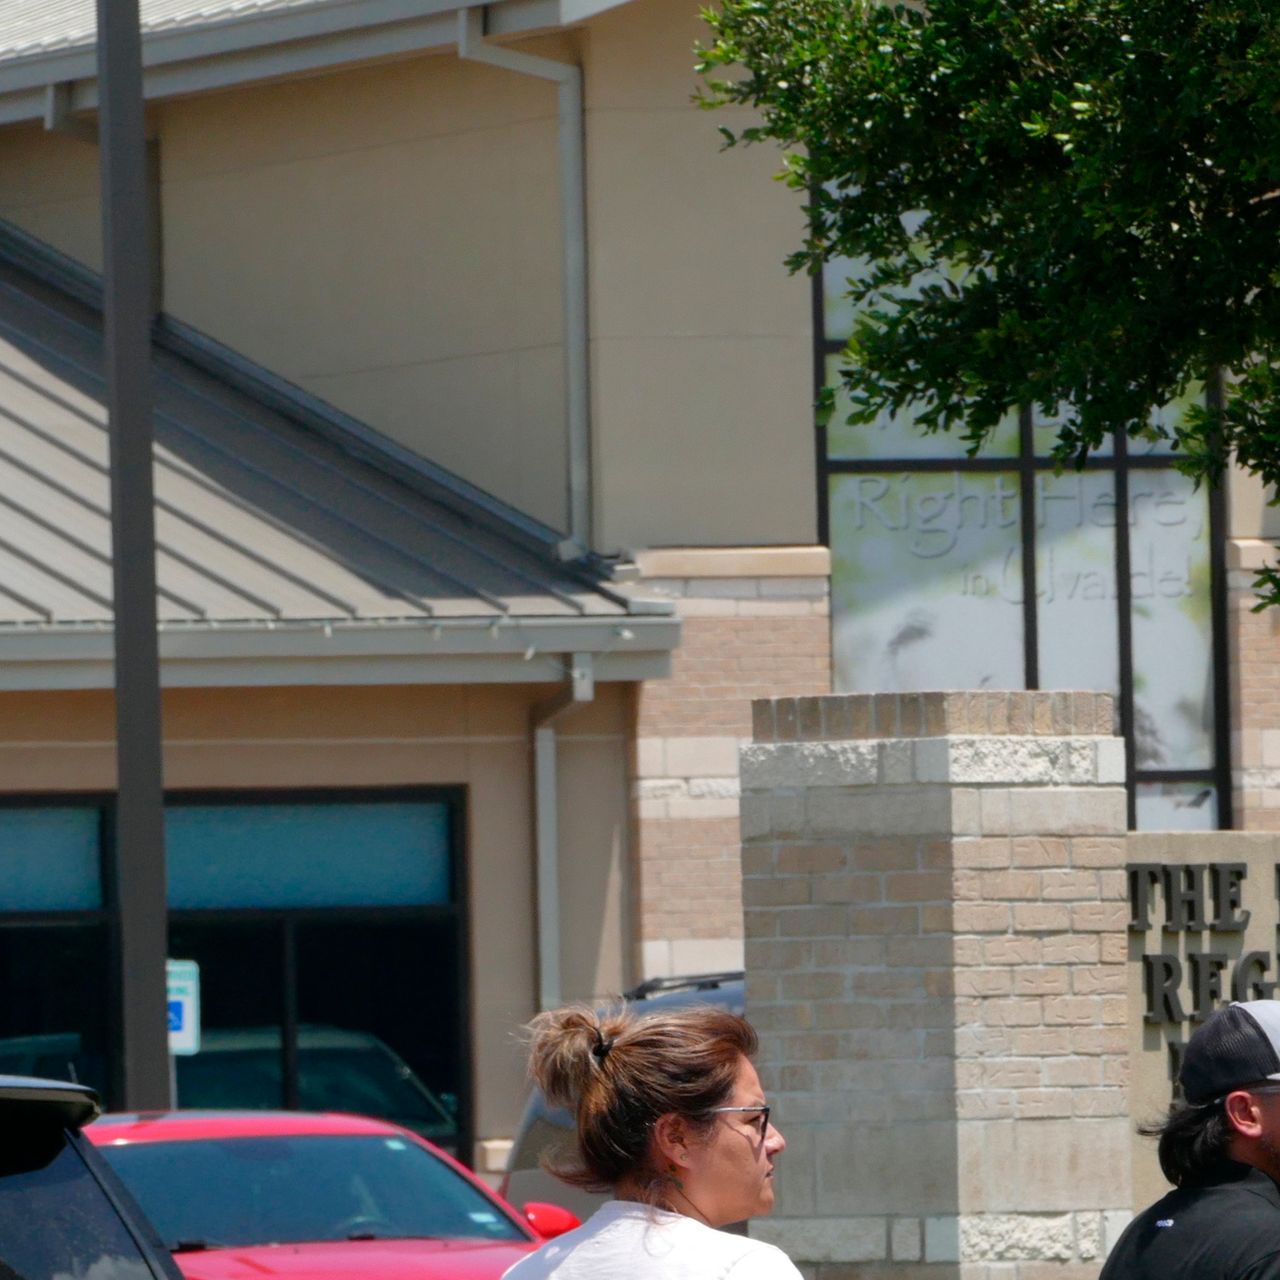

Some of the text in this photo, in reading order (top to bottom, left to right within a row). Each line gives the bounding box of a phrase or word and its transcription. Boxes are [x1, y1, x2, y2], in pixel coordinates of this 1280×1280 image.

[854, 472, 1020, 559] Right
[961, 541, 1193, 605] in Uvade!
[1126, 861, 1251, 931] THE
